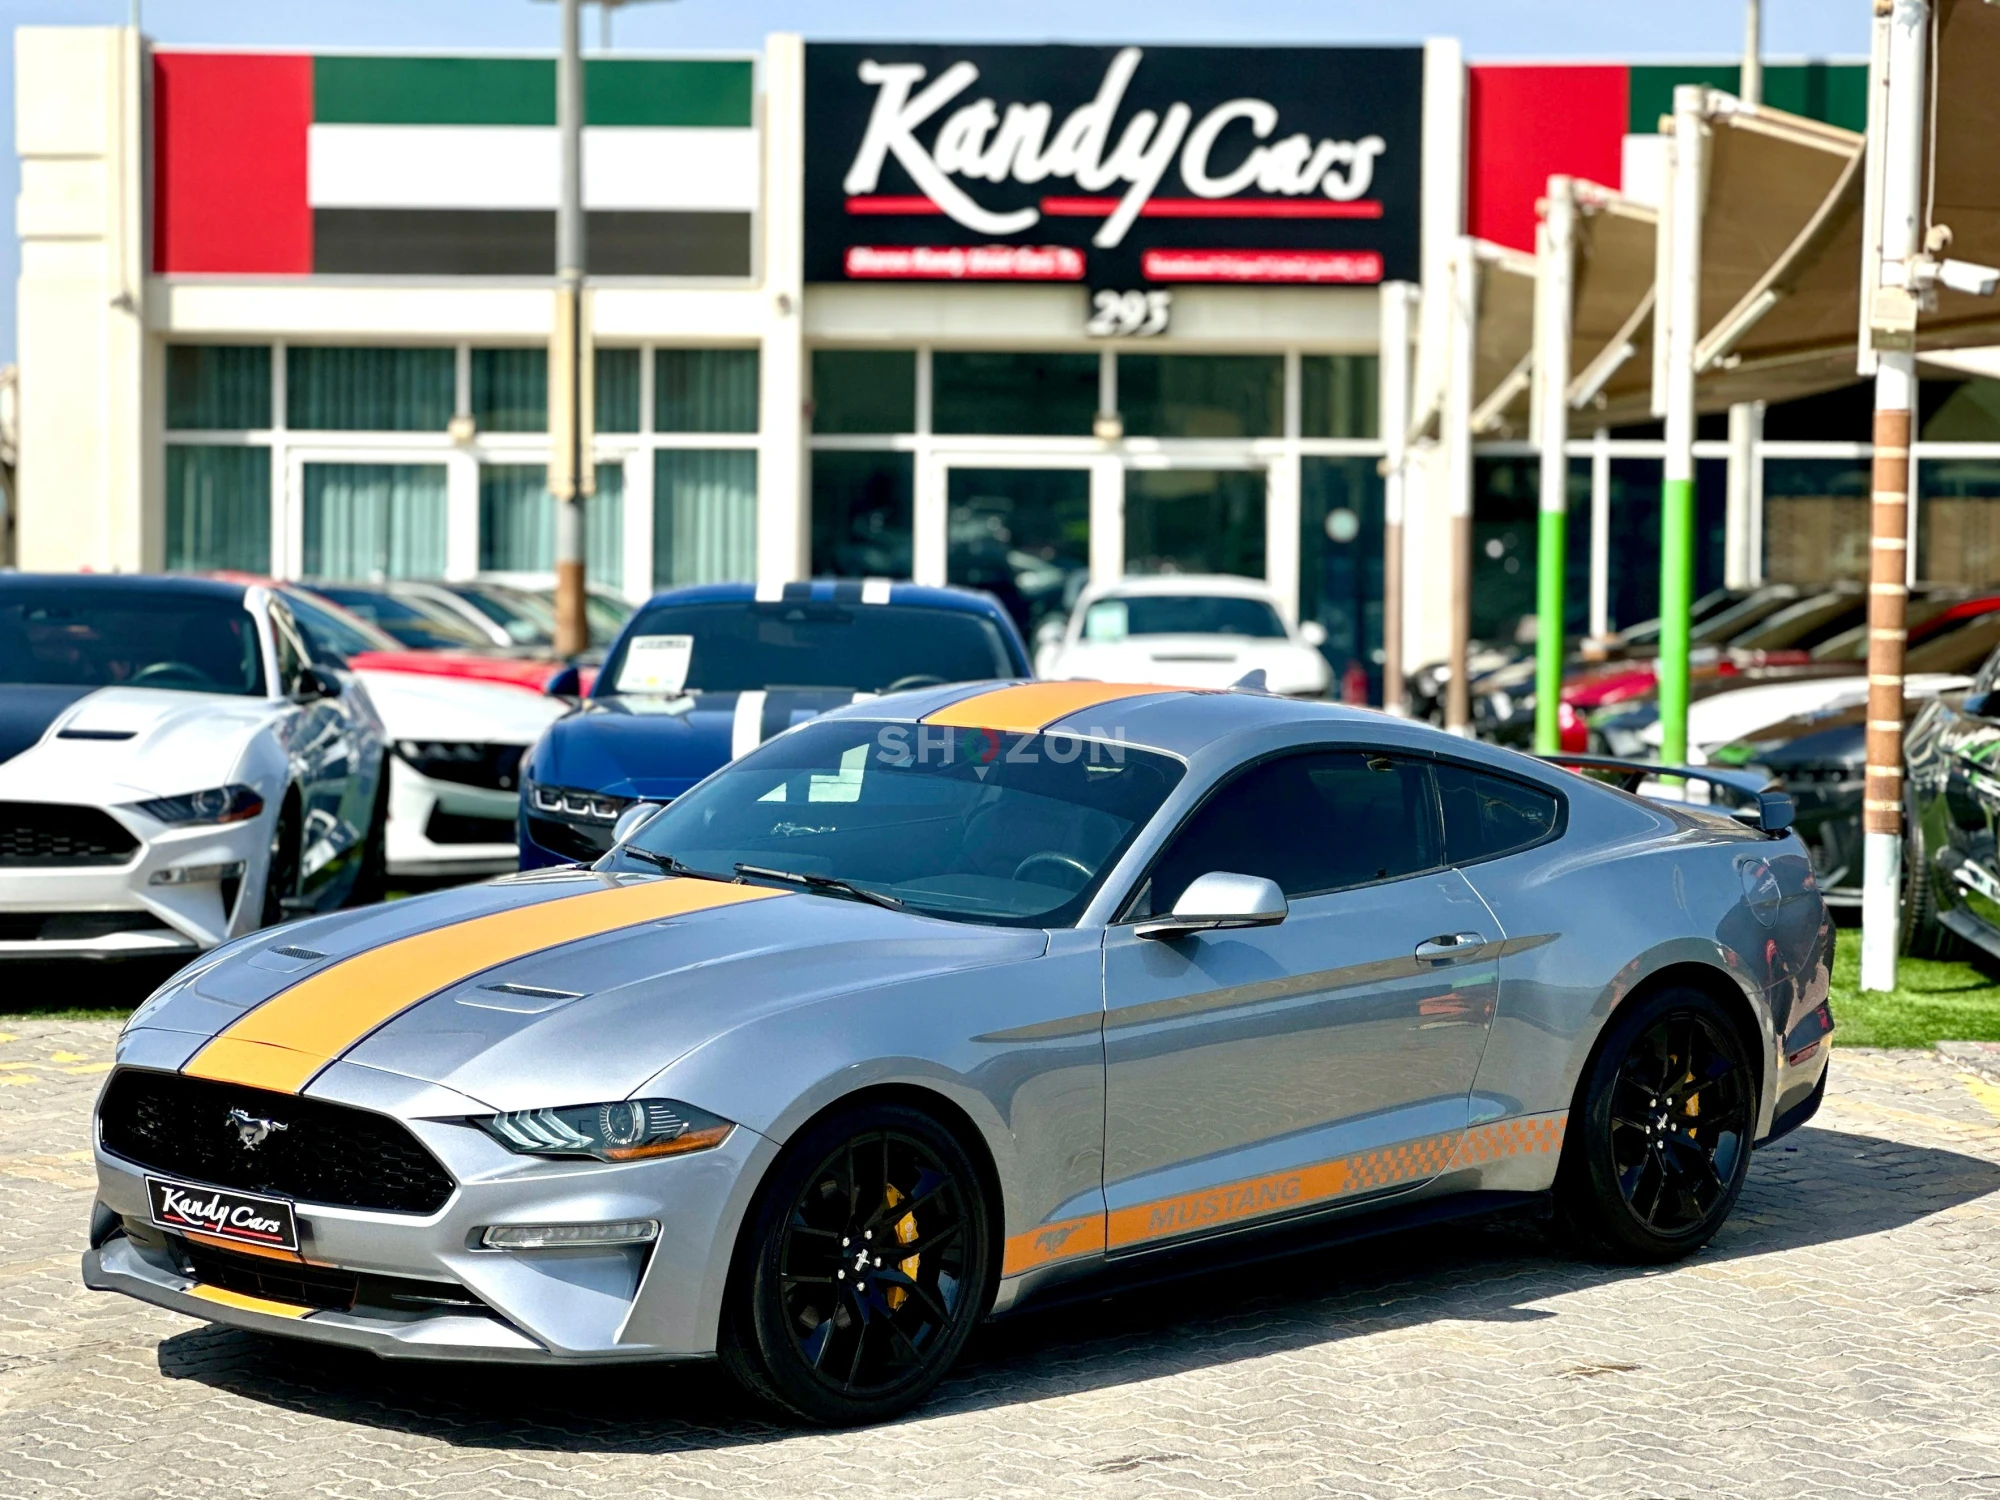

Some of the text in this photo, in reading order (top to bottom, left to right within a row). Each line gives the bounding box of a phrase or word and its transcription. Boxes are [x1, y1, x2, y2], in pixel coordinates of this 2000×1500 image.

[844, 47, 1386, 247] Kandy Cars
[160, 1186, 281, 1233] Kandy Cars
[1149, 1176, 1302, 1232] MUSTANG
